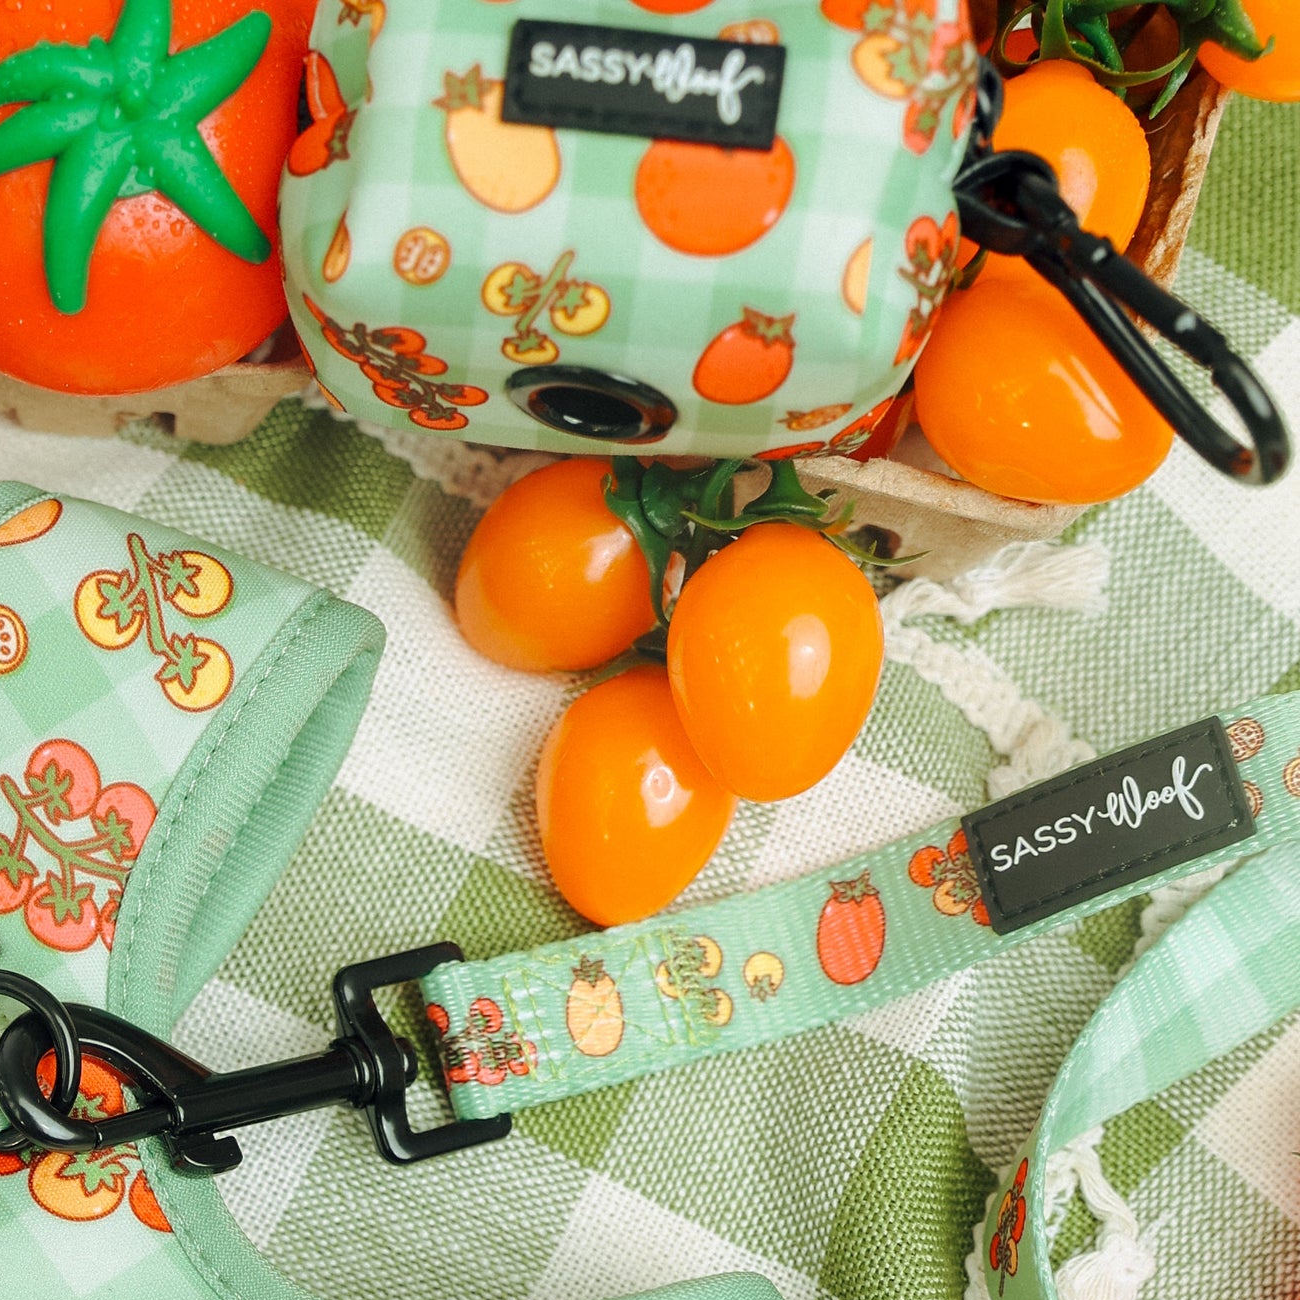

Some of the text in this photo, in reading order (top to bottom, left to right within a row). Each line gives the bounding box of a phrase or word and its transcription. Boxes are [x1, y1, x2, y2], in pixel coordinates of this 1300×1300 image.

[529, 42, 651, 86] SASSY
[990, 756, 1213, 872] SASSY Woof
